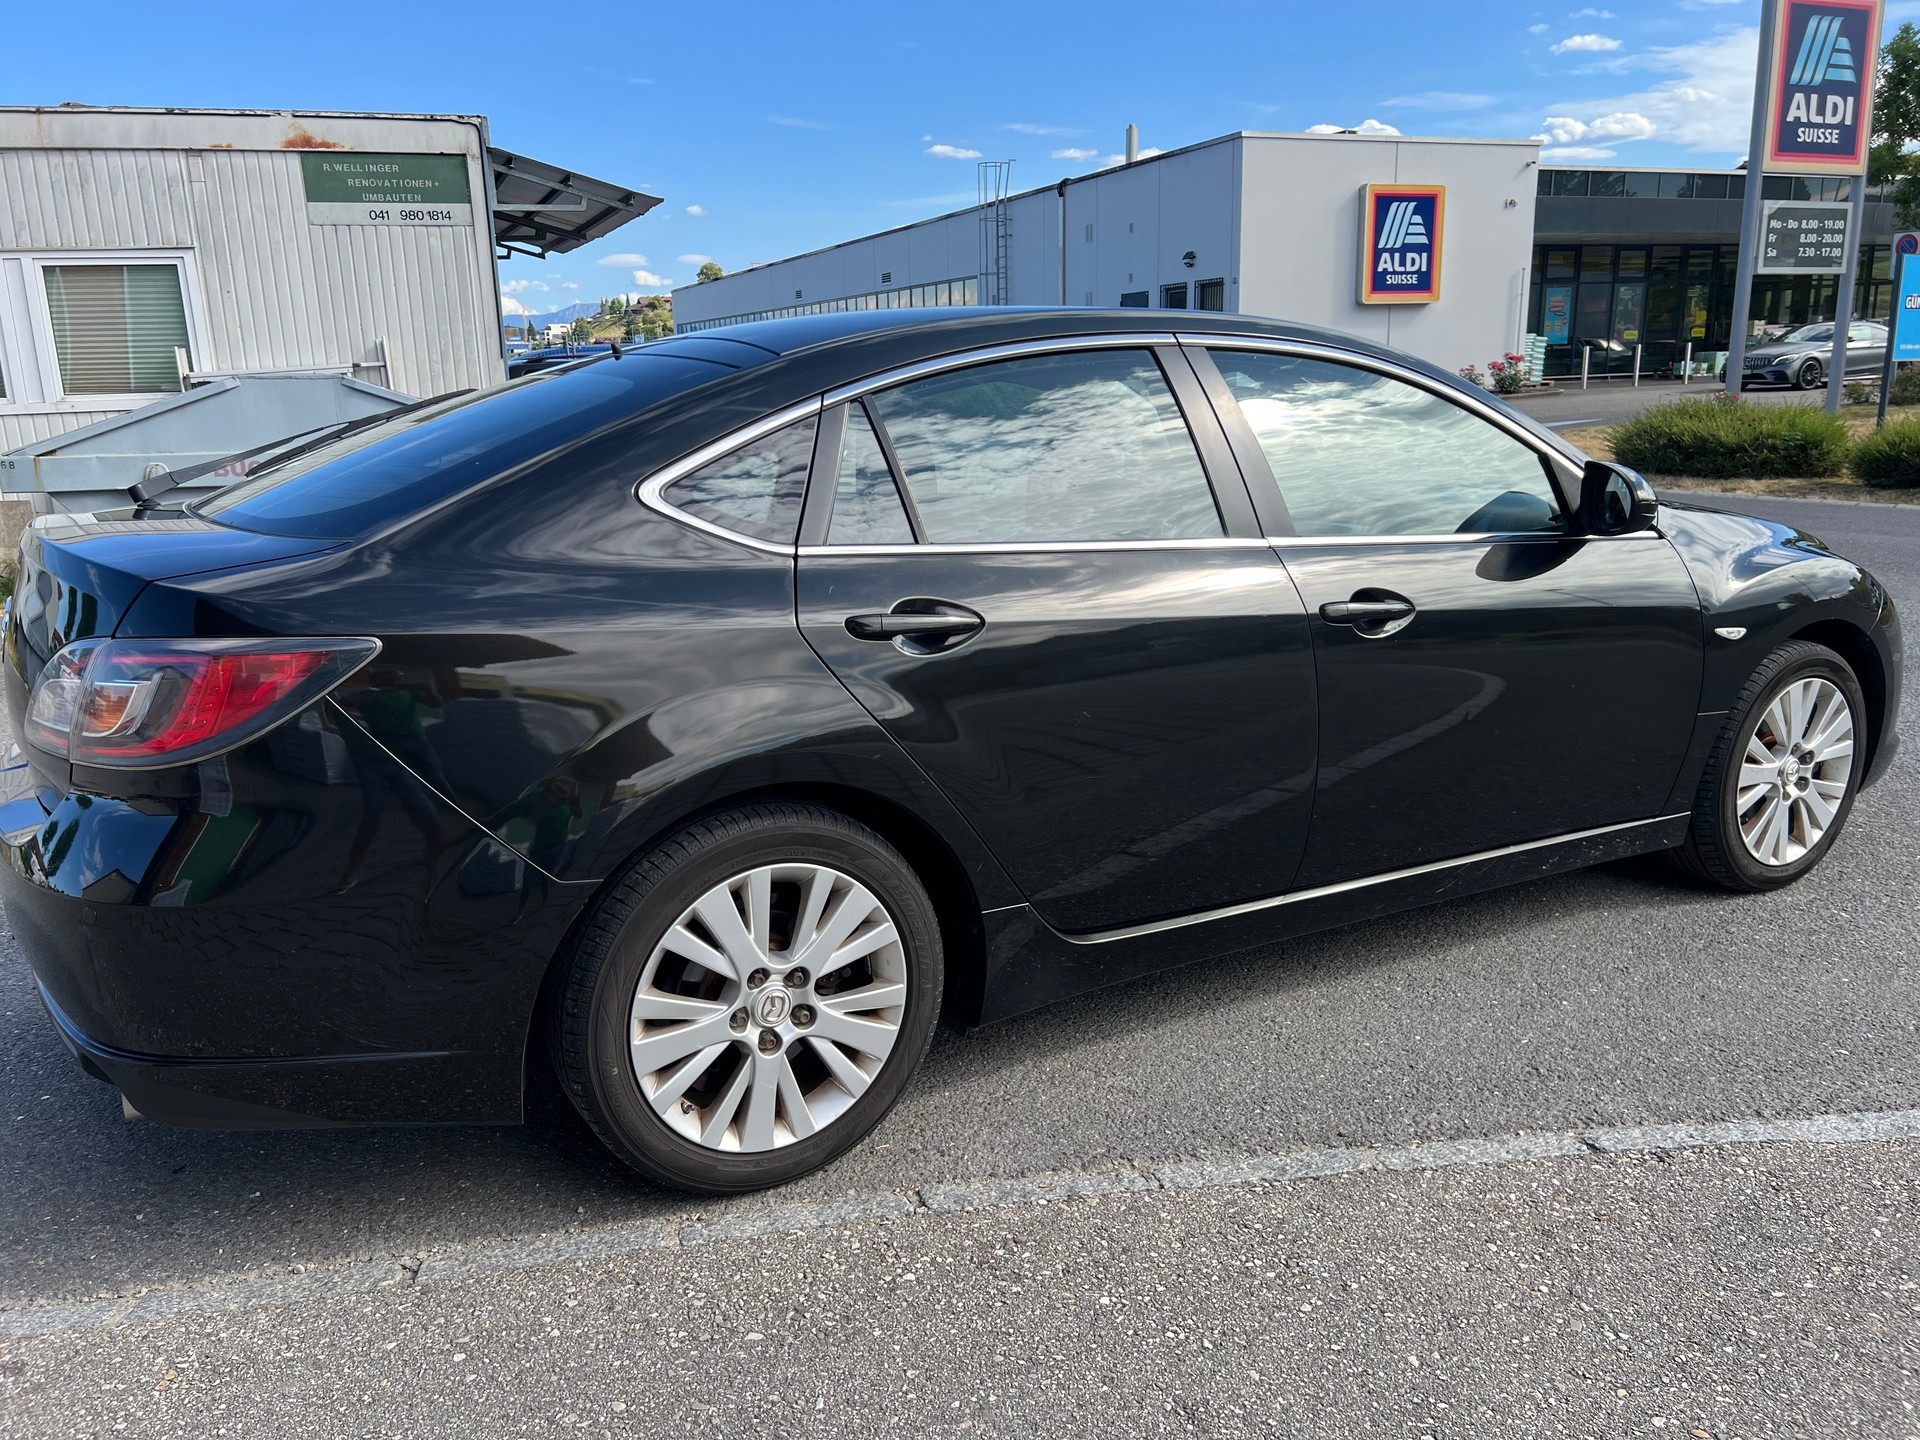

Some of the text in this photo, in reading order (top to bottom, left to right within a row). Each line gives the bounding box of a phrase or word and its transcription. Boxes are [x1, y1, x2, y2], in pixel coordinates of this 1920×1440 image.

[1786, 92, 1854, 125] ALDI
[1797, 127, 1840, 144] SUISSE
[333, 163, 399, 173] WELLINGER
[362, 193, 422, 202] UMBAUTEN
[368, 209, 452, 221] 041 980 1814
[1769, 219, 1782, 229] Mo
[1787, 219, 1798, 229] Do
[1801, 219, 1818, 229] 8.00
[1824, 219, 1844, 229] 19.00
[1768, 233, 1777, 242] Fr
[1799, 233, 1818, 243] 8.00
[1822, 233, 1843, 243] 20.00
[1766, 247, 1777, 257] Sa
[1797, 247, 1815, 257] 7.30
[1821, 247, 1842, 257] 17.00
[1377, 252, 1428, 272] ALDI
[1385, 274, 1419, 284] SUISSE
